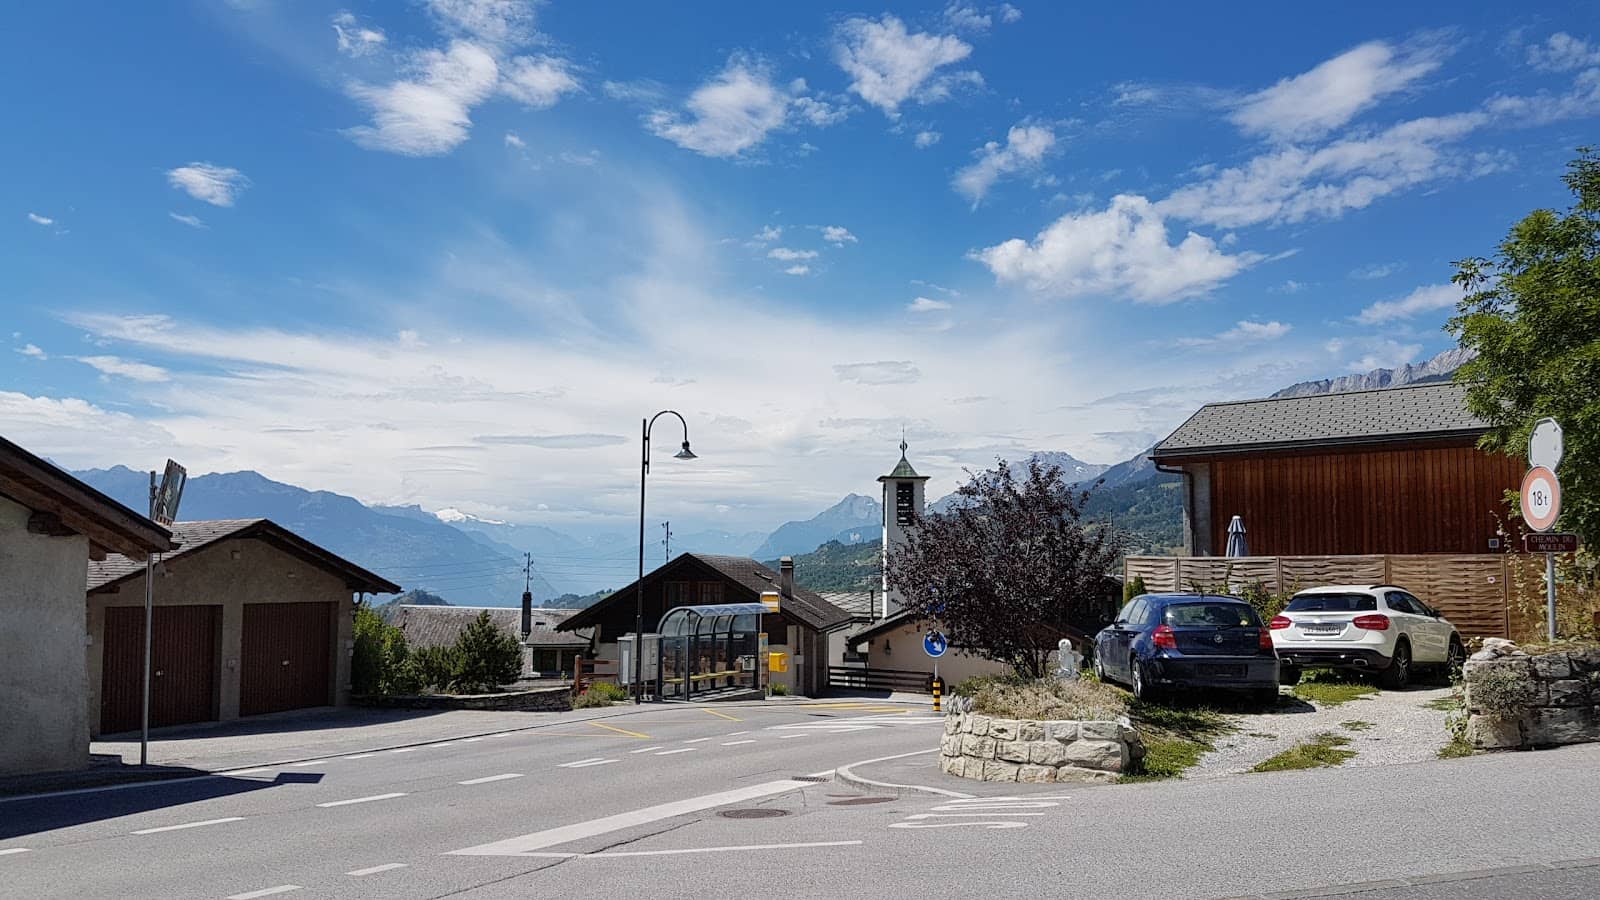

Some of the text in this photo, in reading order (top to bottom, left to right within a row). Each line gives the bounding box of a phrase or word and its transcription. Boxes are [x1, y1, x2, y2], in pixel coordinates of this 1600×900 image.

[1532, 490, 1548, 506] 18 t
[1530, 535, 1574, 543] CHEMIN DU
